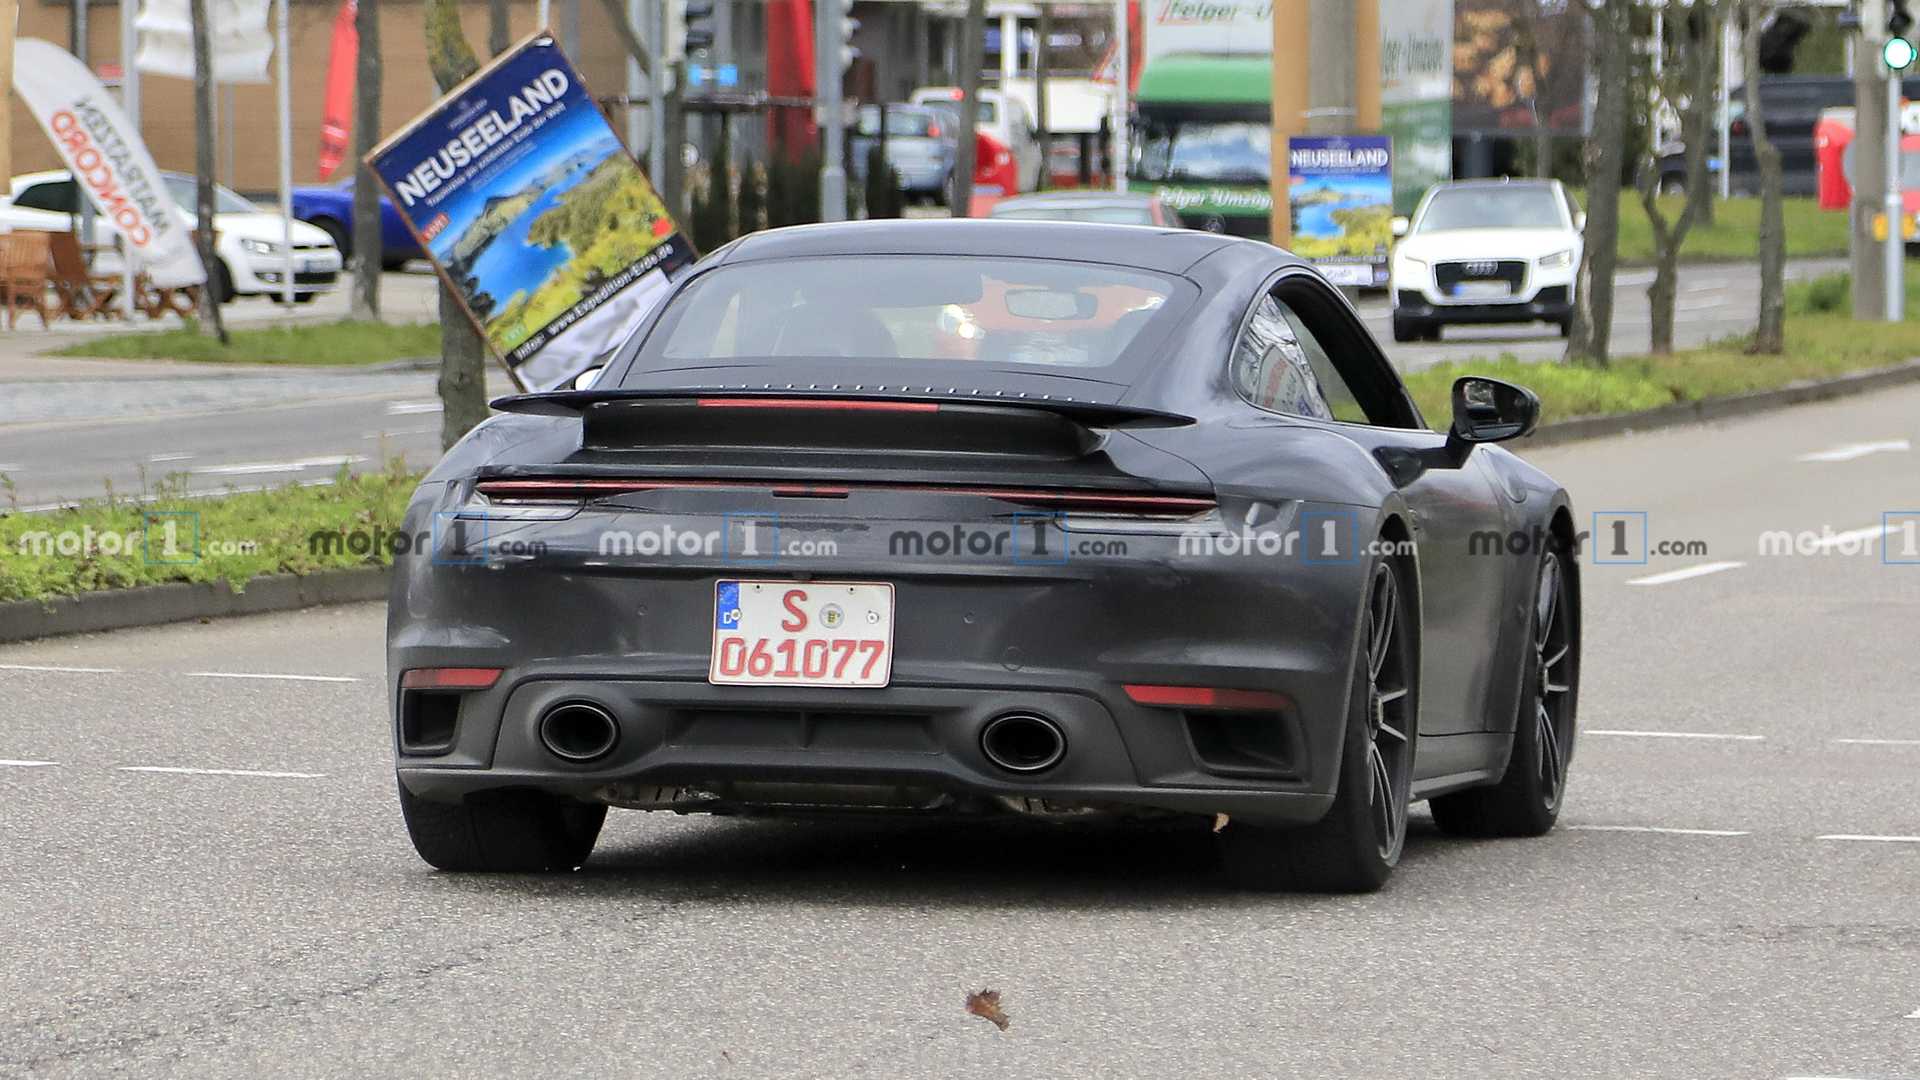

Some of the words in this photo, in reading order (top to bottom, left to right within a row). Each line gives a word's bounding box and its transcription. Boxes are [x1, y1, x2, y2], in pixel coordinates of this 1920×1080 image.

[394, 68, 569, 207] NEUSEELAND
[1291, 148, 1389, 169] NEUSEELAND
[781, 589, 809, 633] S
[719, 636, 886, 680] 061077
